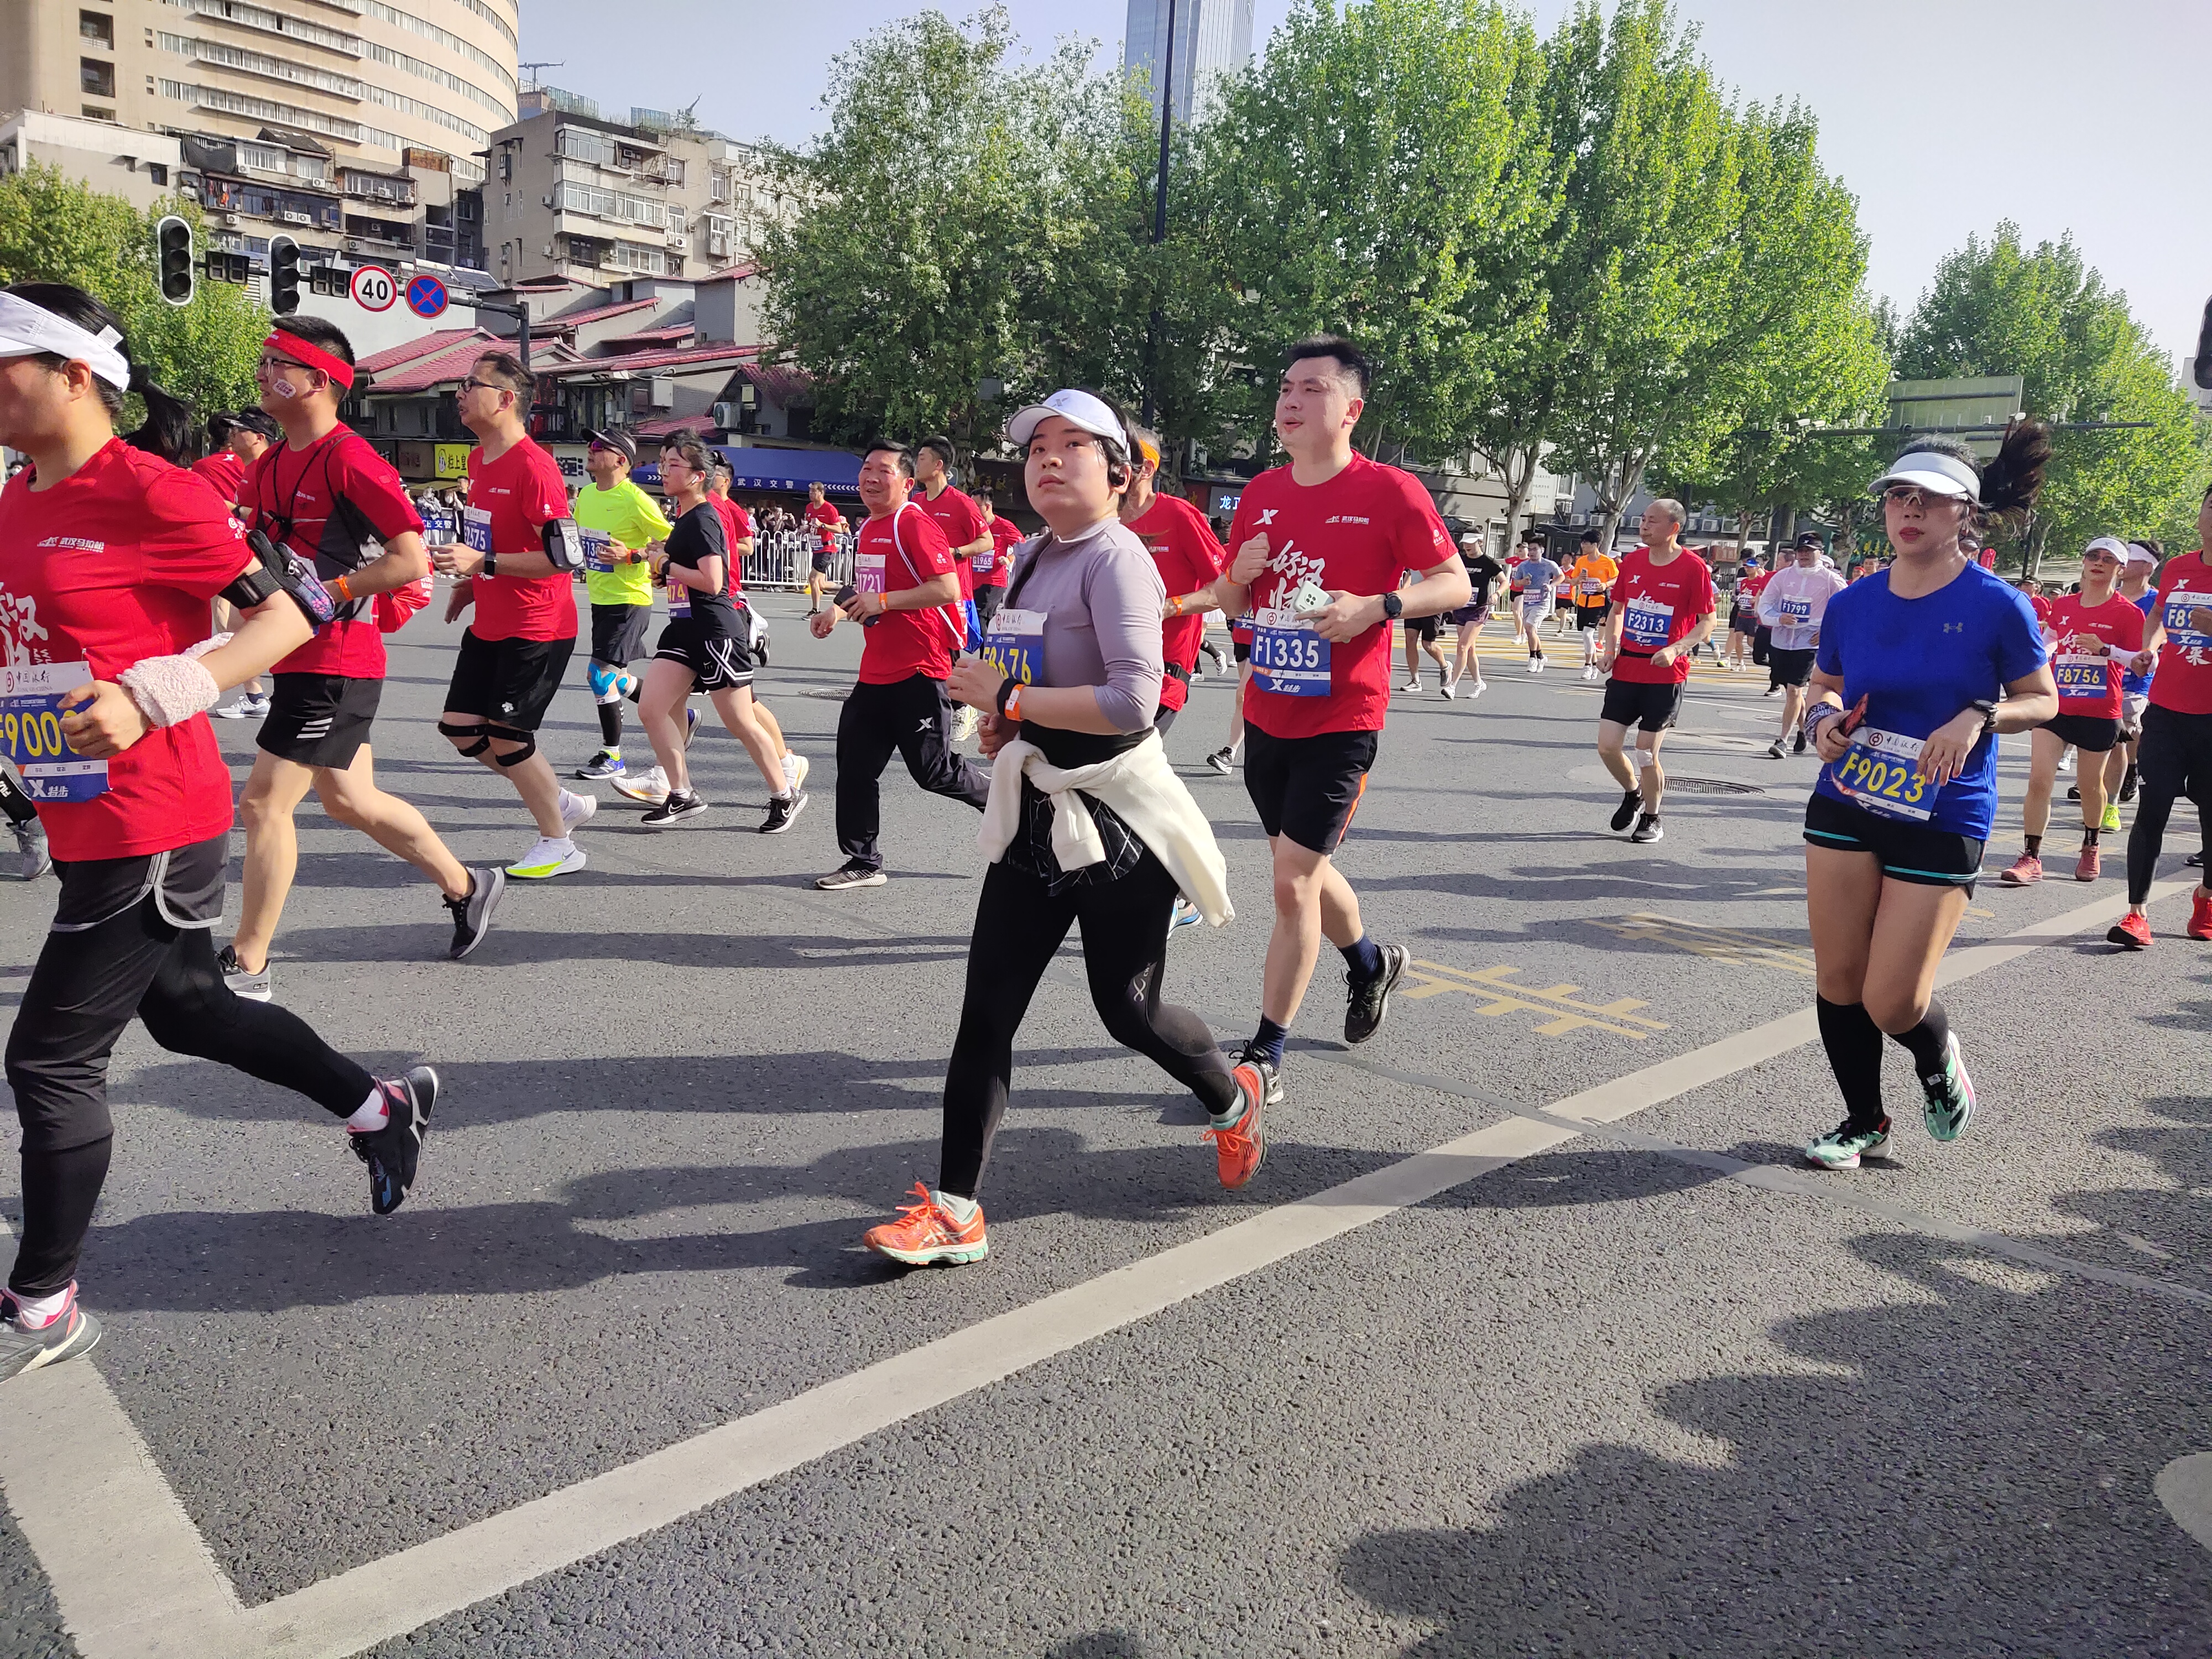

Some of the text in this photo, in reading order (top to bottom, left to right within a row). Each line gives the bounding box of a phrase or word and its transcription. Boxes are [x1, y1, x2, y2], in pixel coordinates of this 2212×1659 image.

[362, 278, 388, 300] 40
[737, 478, 794, 489] 武汉交警
[435, 519, 452, 529] 交警
[59, 537, 105, 550] 武汉马拉松
[973, 556, 993, 565] G1965
[856, 573, 881, 593] 1721
[1782, 602, 1807, 614] F1799
[1627, 612, 1665, 632] F2313
[1255, 635, 1319, 668] F1335
[17, 670, 50, 684] 中国银行
[2057, 668, 2100, 684] F8756
[0, 709, 80, 758] 900
[1839, 752, 1926, 802] F9023
